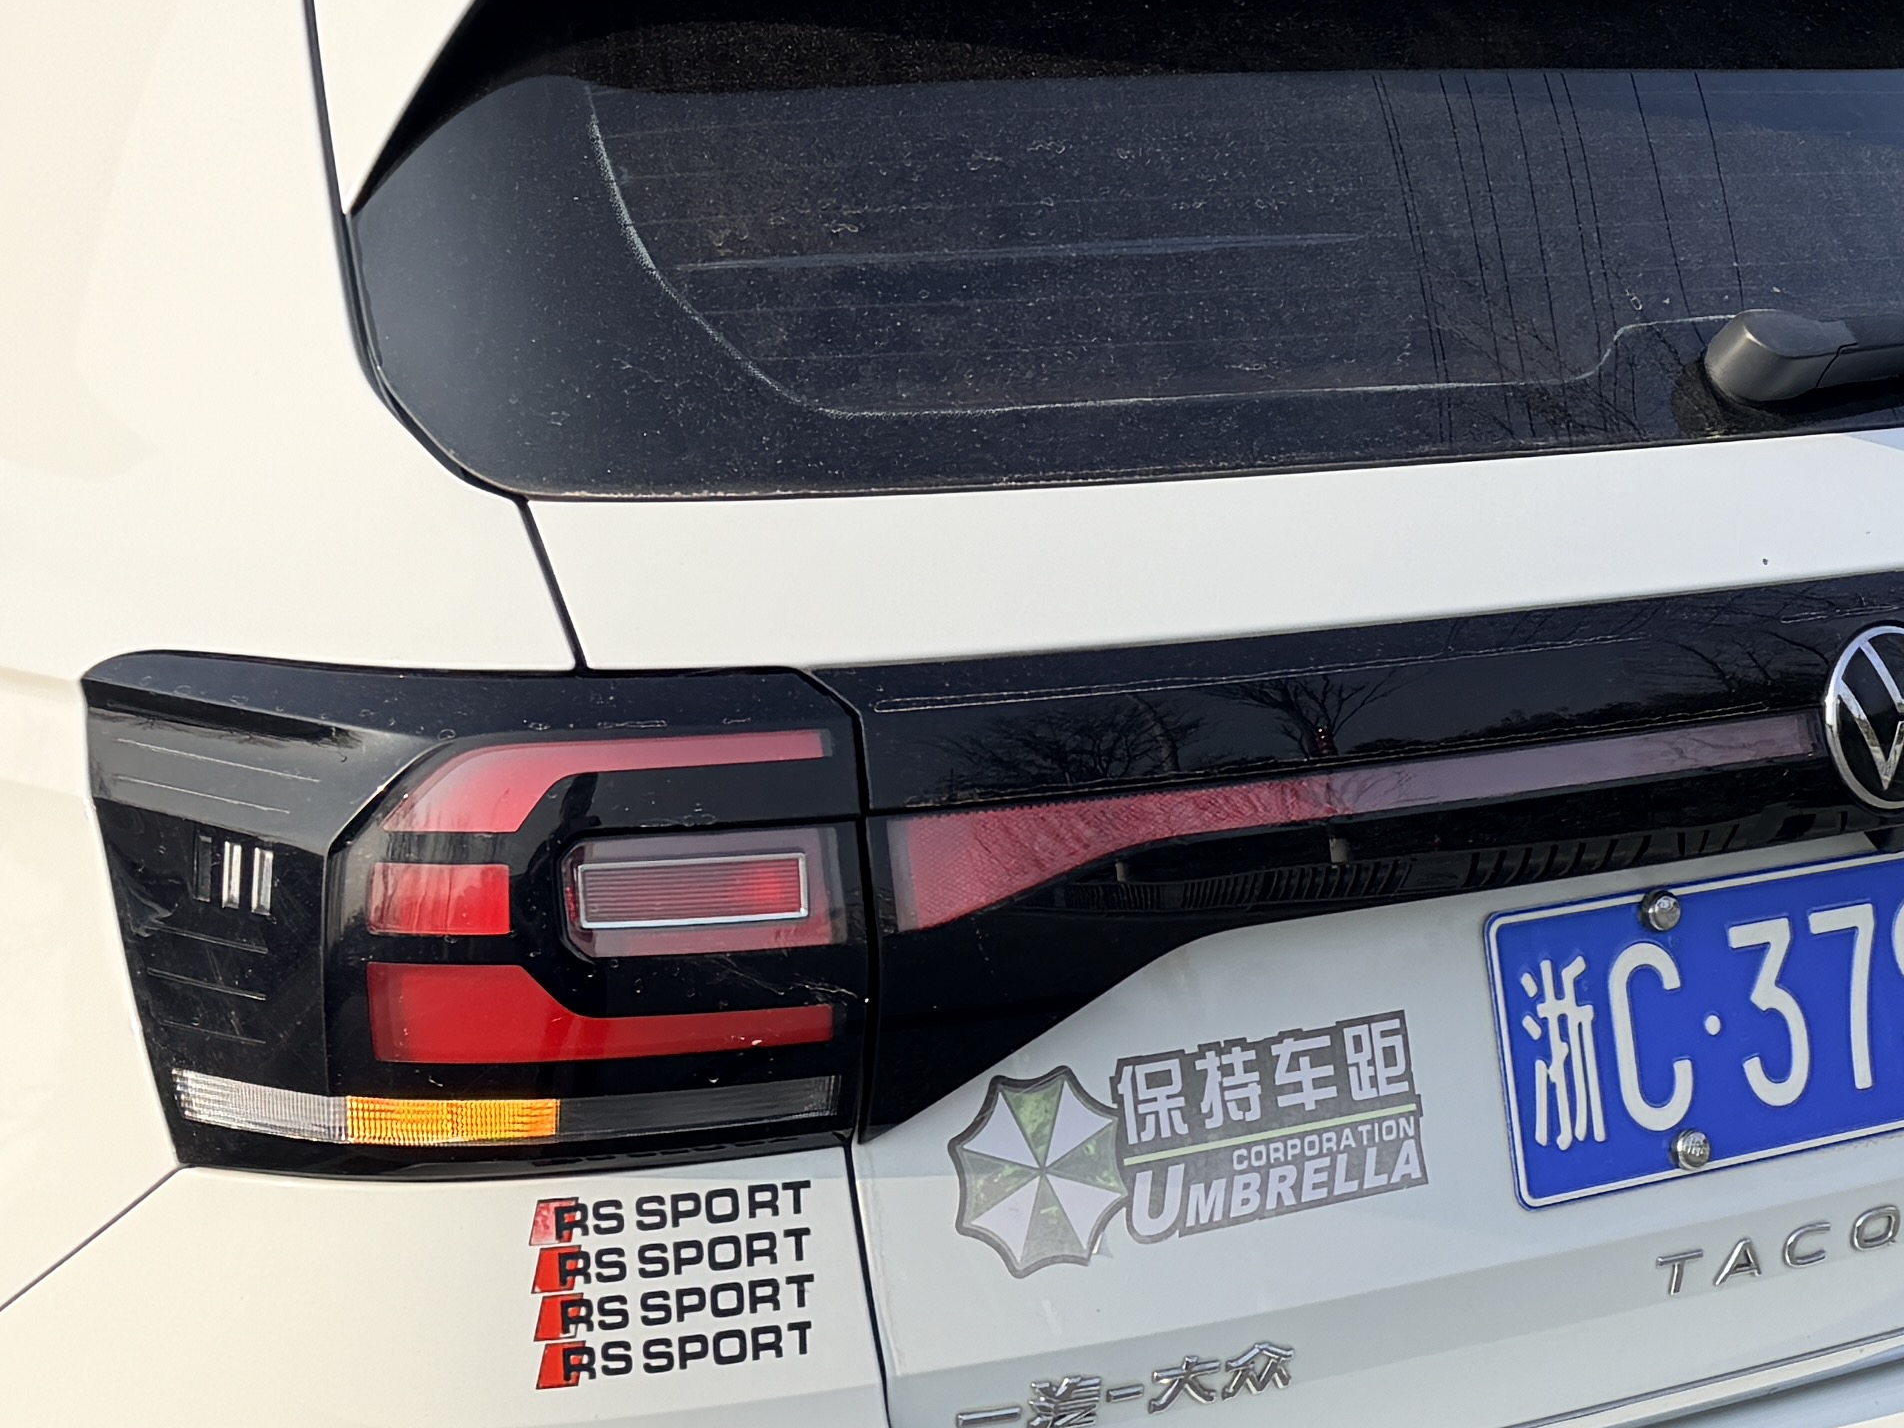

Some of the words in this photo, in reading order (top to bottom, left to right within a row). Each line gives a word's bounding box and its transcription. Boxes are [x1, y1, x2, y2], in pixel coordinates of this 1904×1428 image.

[1117, 1018, 1409, 1144] 保持车距
[1232, 1116, 1416, 1171] CORPORATION
[554, 1199, 625, 1240] RS
[635, 1180, 811, 1231] SPORT
[1131, 1140, 1423, 1238] UMBRELLA
[557, 1247, 628, 1286] RS
[637, 1227, 811, 1279] SPORT
[560, 1295, 630, 1335] RS
[640, 1274, 815, 1327] SPORT
[562, 1340, 633, 1381] RS
[642, 1321, 812, 1374] SPORT
